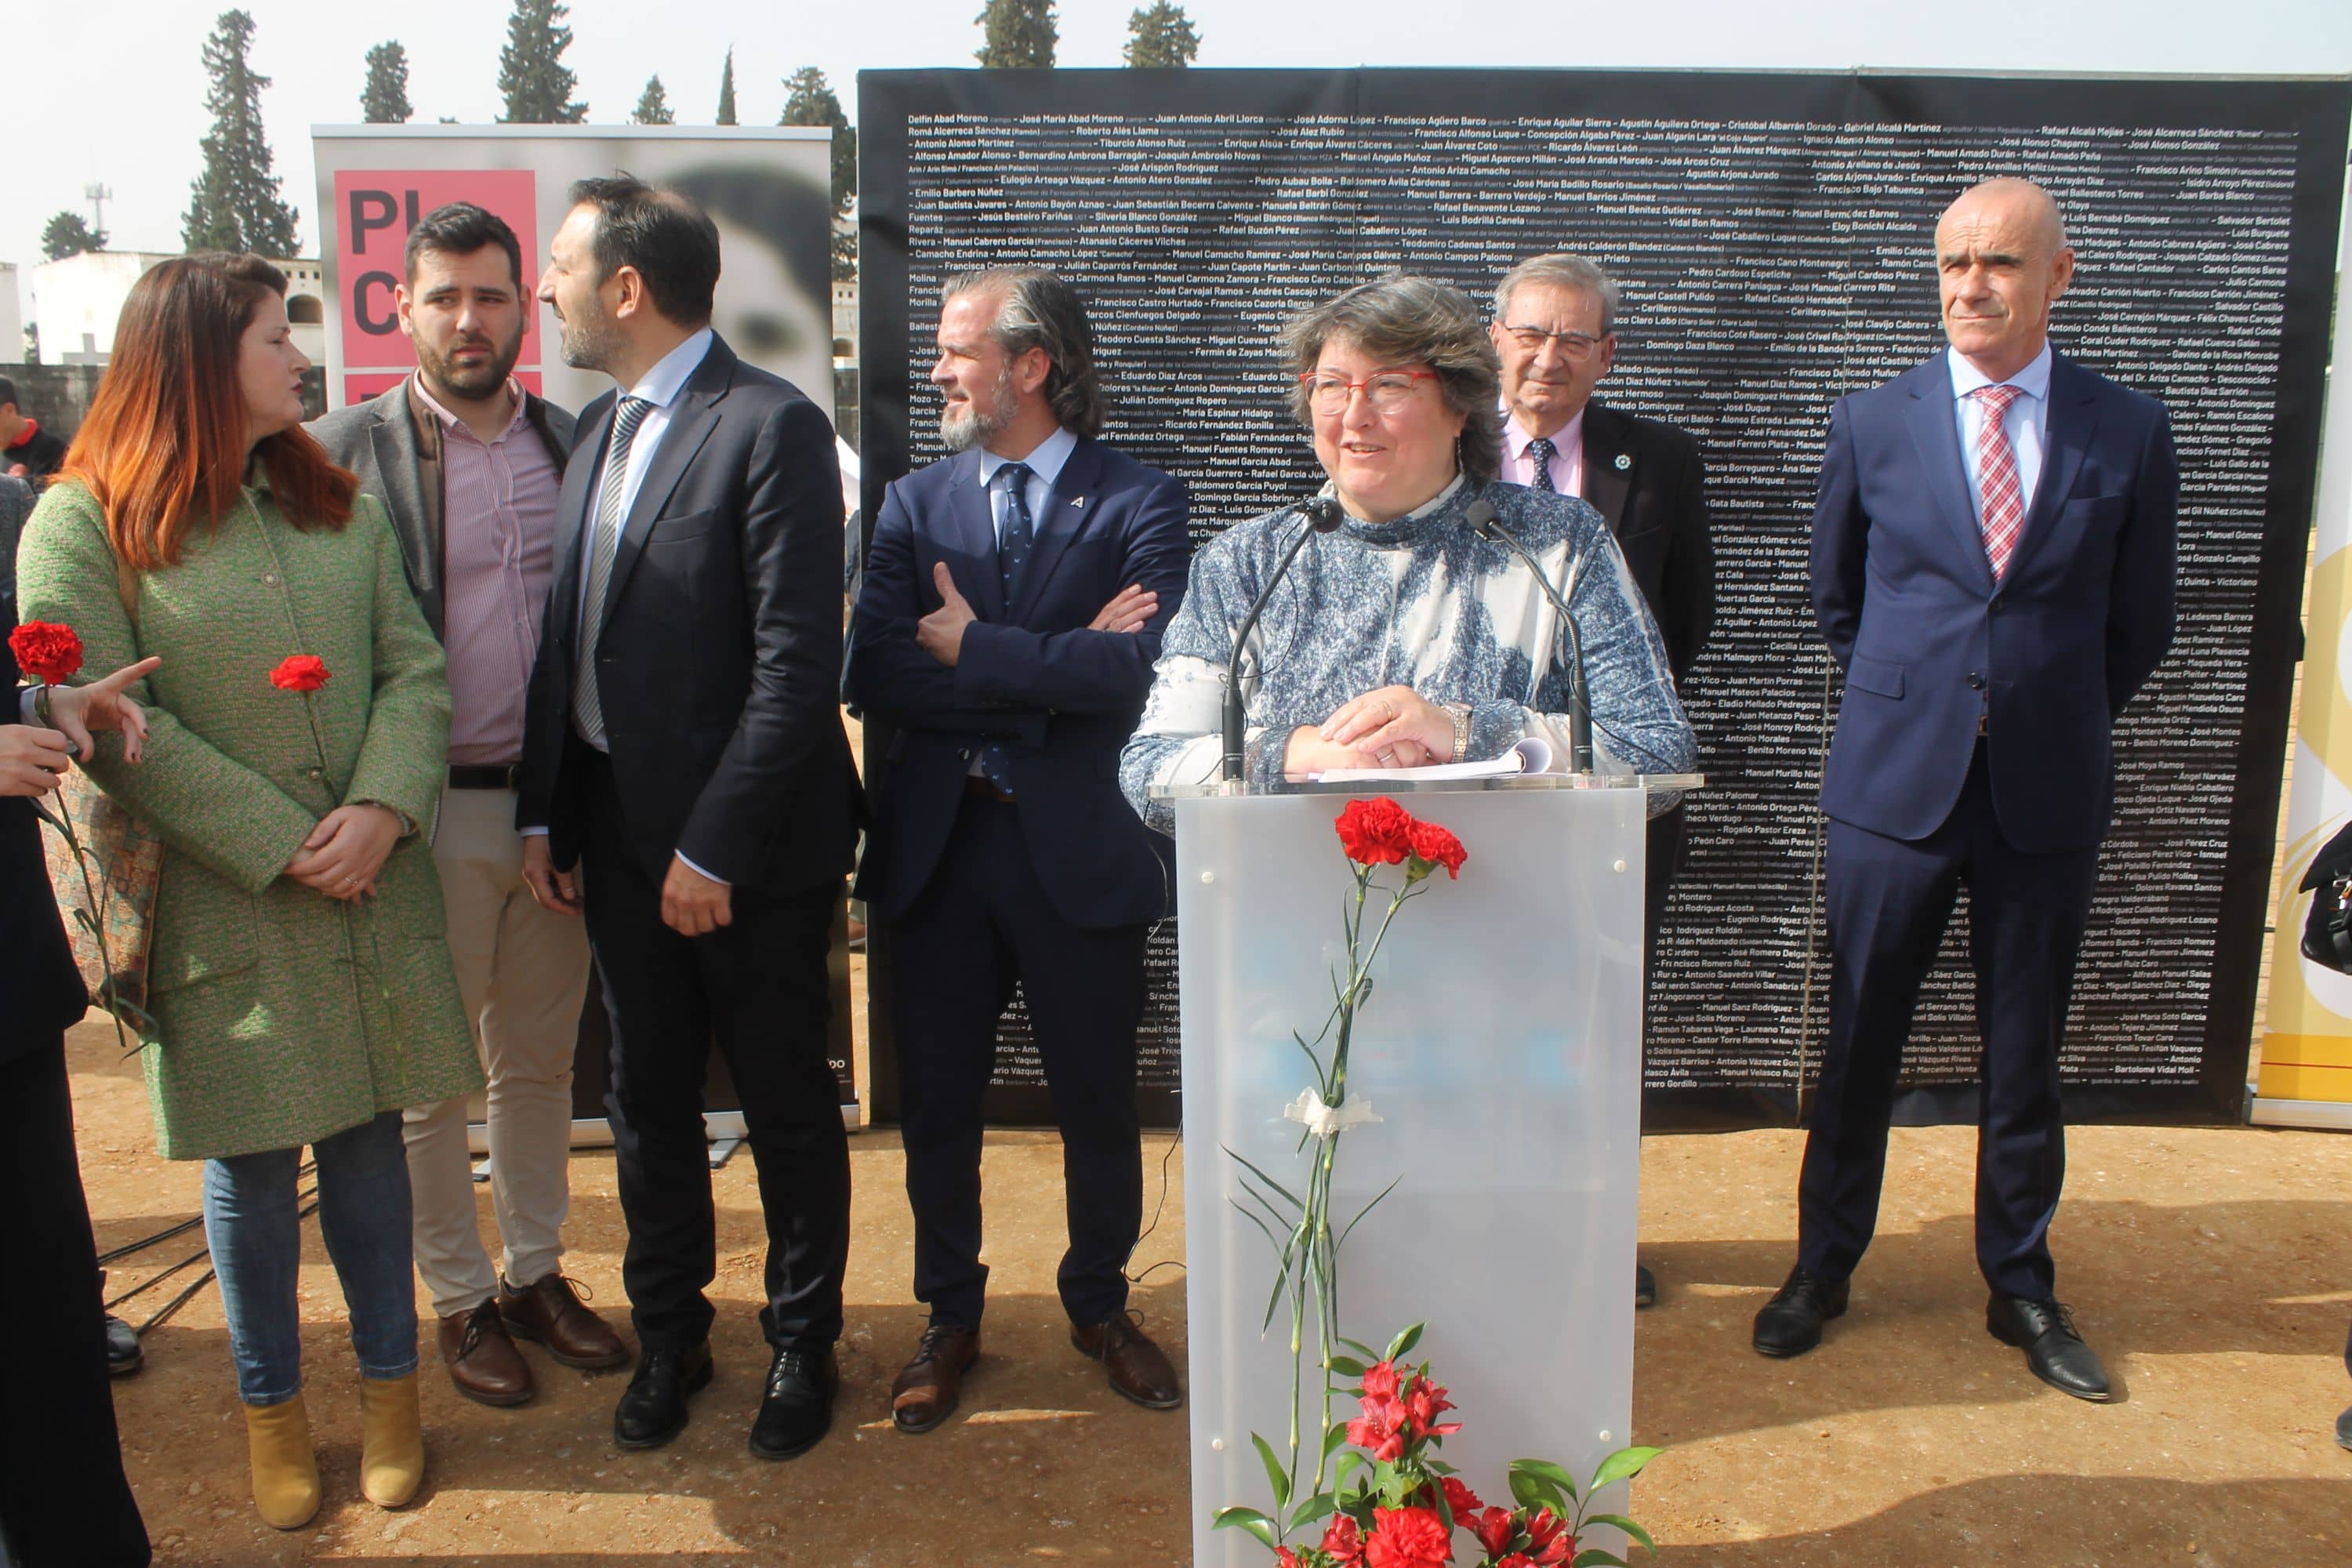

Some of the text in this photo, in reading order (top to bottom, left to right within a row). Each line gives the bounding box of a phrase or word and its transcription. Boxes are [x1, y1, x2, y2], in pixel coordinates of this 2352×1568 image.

[934, 114, 954, 123] Abad
[956, 114, 988, 122] Moreno
[1178, 114, 1212, 122] Antonio
[1384, 116, 1486, 127] Francisco Agüero Barco
[1518, 117, 1610, 129] Enrique Aguilar Sierra
[975, 125, 1011, 135] Sánchez
[1728, 120, 1835, 131] Cristóbal Albarrán Dorado
[1527, 130, 1635, 141] Concepción Algaba Pérez
[1225, 139, 1257, 149] Enrique
[1290, 139, 1392, 150] Enrique Álvarez Cáceres
[1549, 142, 1637, 152] Ricardo Álvarez León
[2126, 140, 2219, 150] José Alonso González
[1708, 144, 1802, 156] Juan Álvarez Márquez
[1927, 148, 2017, 158] Manuel Amado Durán
[915, 151, 1010, 160] Alfonso Amador Alonso
[1018, 151, 1065, 159] Bernardino
[1108, 151, 1146, 161] Barragán
[1564, 155, 1653, 165] José Aranda Marcelo
[1958, 161, 1984, 170] Pedro
[1985, 162, 2021, 170] Arenillas
[1000, 175, 1105, 185] Eulogio Arteaga Vázquez
[2187, 178, 2265, 189] Isidro Arroyo Pérez
[915, 187, 1003, 197] Emilio Barbero Núñez
[1554, 192, 1656, 201] Manuel Barrios Jiménez
[2176, 191, 2198, 199] Juan
[2225, 191, 2254, 200] Blanco
[915, 200, 1007, 209] Juan Bautista Javares
[1014, 199, 1047, 208] Antonio
[1051, 199, 1076, 209] Bayón
[909, 212, 942, 221] Fuentes
[978, 212, 1073, 221] Jesús Besteiro Fariñas
[1275, 225, 1301, 234] Pérez
[974, 237, 1006, 245] Cabrero
[1709, 231, 1798, 243] José Caballero Luque
[1557, 241, 1587, 250] Andrés
[1588, 241, 1627, 250] Calderón
[916, 249, 954, 258] Camacho
[996, 249, 1098, 259] Antonio Camacho López
[2225, 277, 2286, 287] Julio Carmona
[2218, 314, 2249, 322] Chaves
[1646, 340, 1684, 351] Domingo
[1686, 341, 1705, 350] Daza
[909, 394, 931, 403] Mozo
[1723, 403, 1770, 413] José Duque
[1200, 420, 1243, 429] Fernández
[1245, 420, 1273, 429] Bonilla
[1737, 439, 1766, 448] Ferrero
[1767, 440, 1788, 448] Plata
[1214, 445, 1247, 453] Fuentes
[1769, 583, 1803, 591] Santana
[1777, 700, 1820, 710] Pedregosa
[2179, 771, 2201, 781] Ángel
[1723, 826, 1753, 834] Rogelio
[1011, 1067, 1044, 1076] Vázquez
